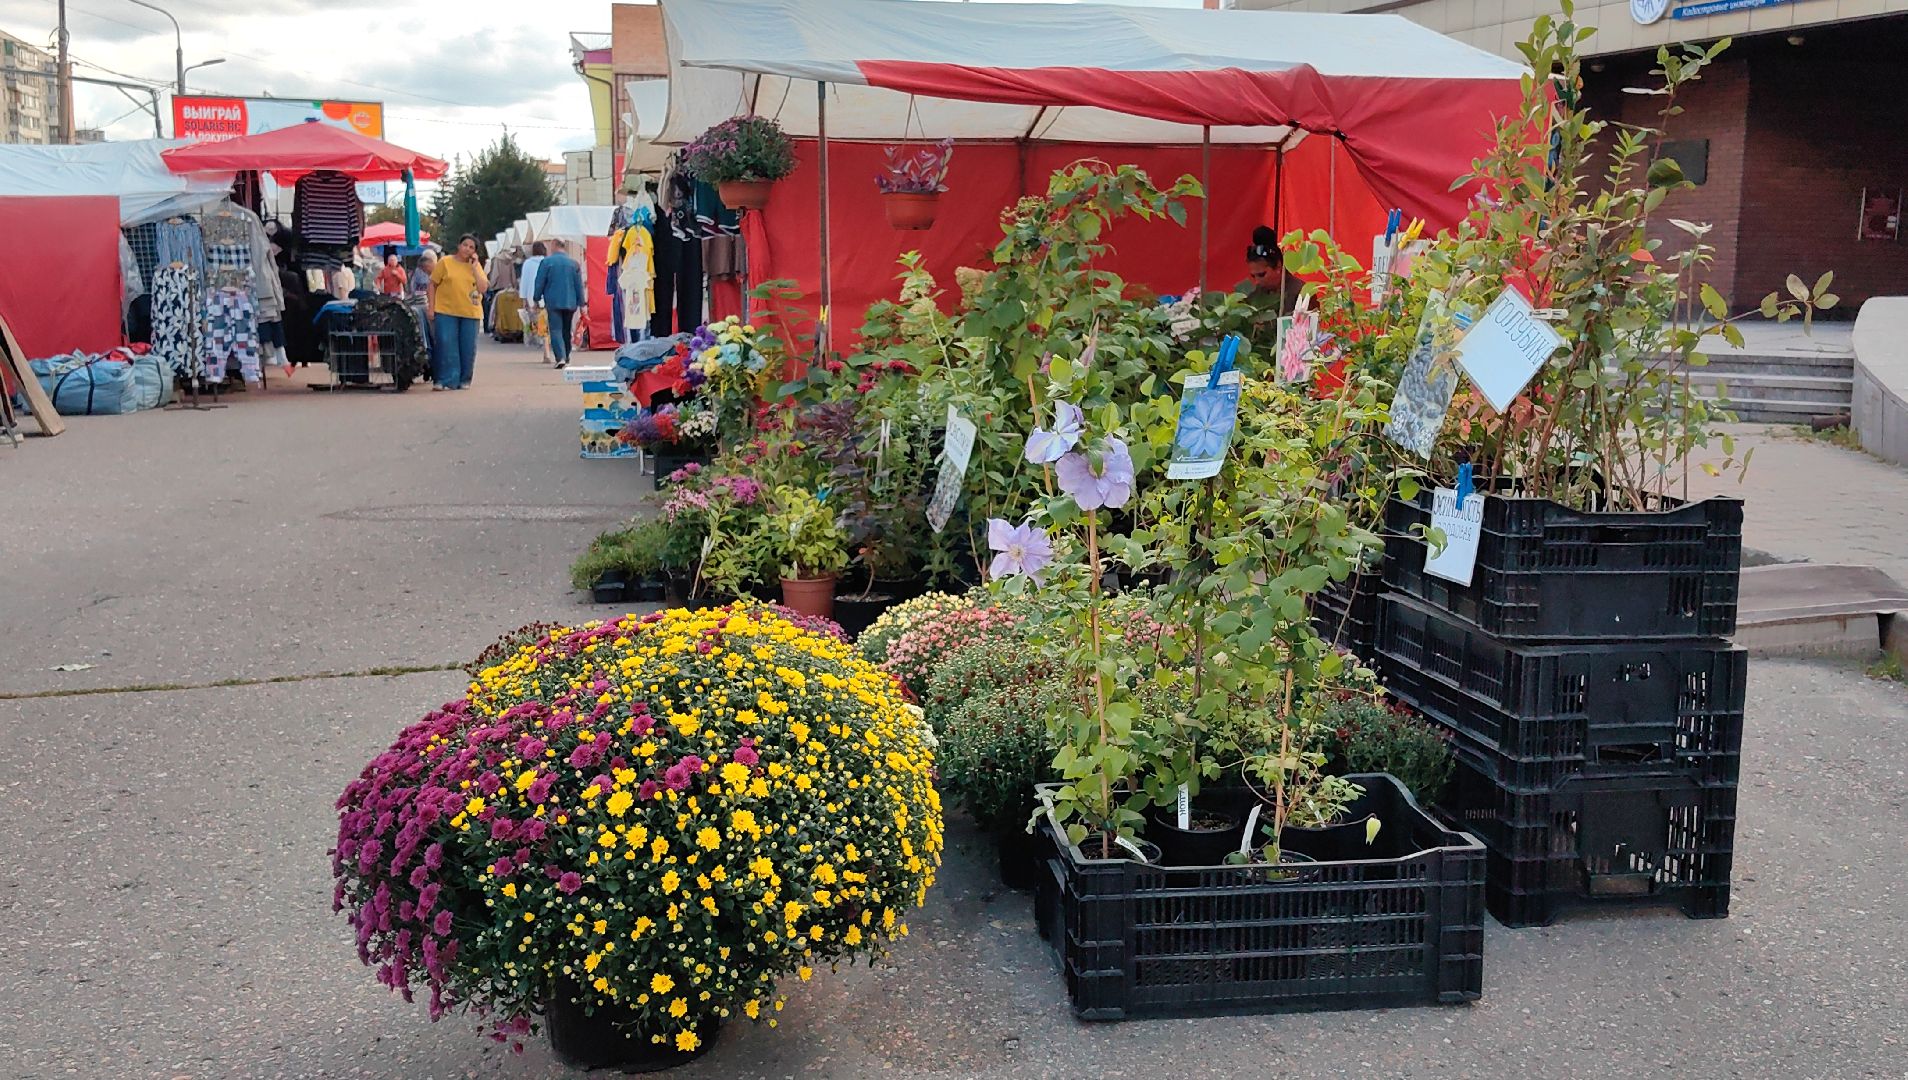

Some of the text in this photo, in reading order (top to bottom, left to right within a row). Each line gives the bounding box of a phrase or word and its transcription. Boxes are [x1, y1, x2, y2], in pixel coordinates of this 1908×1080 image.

[183, 104, 241, 120] ВЫИГРАЙ
[184, 120, 224, 131] SOLARIS
[366, 187, 380, 197] 18+
